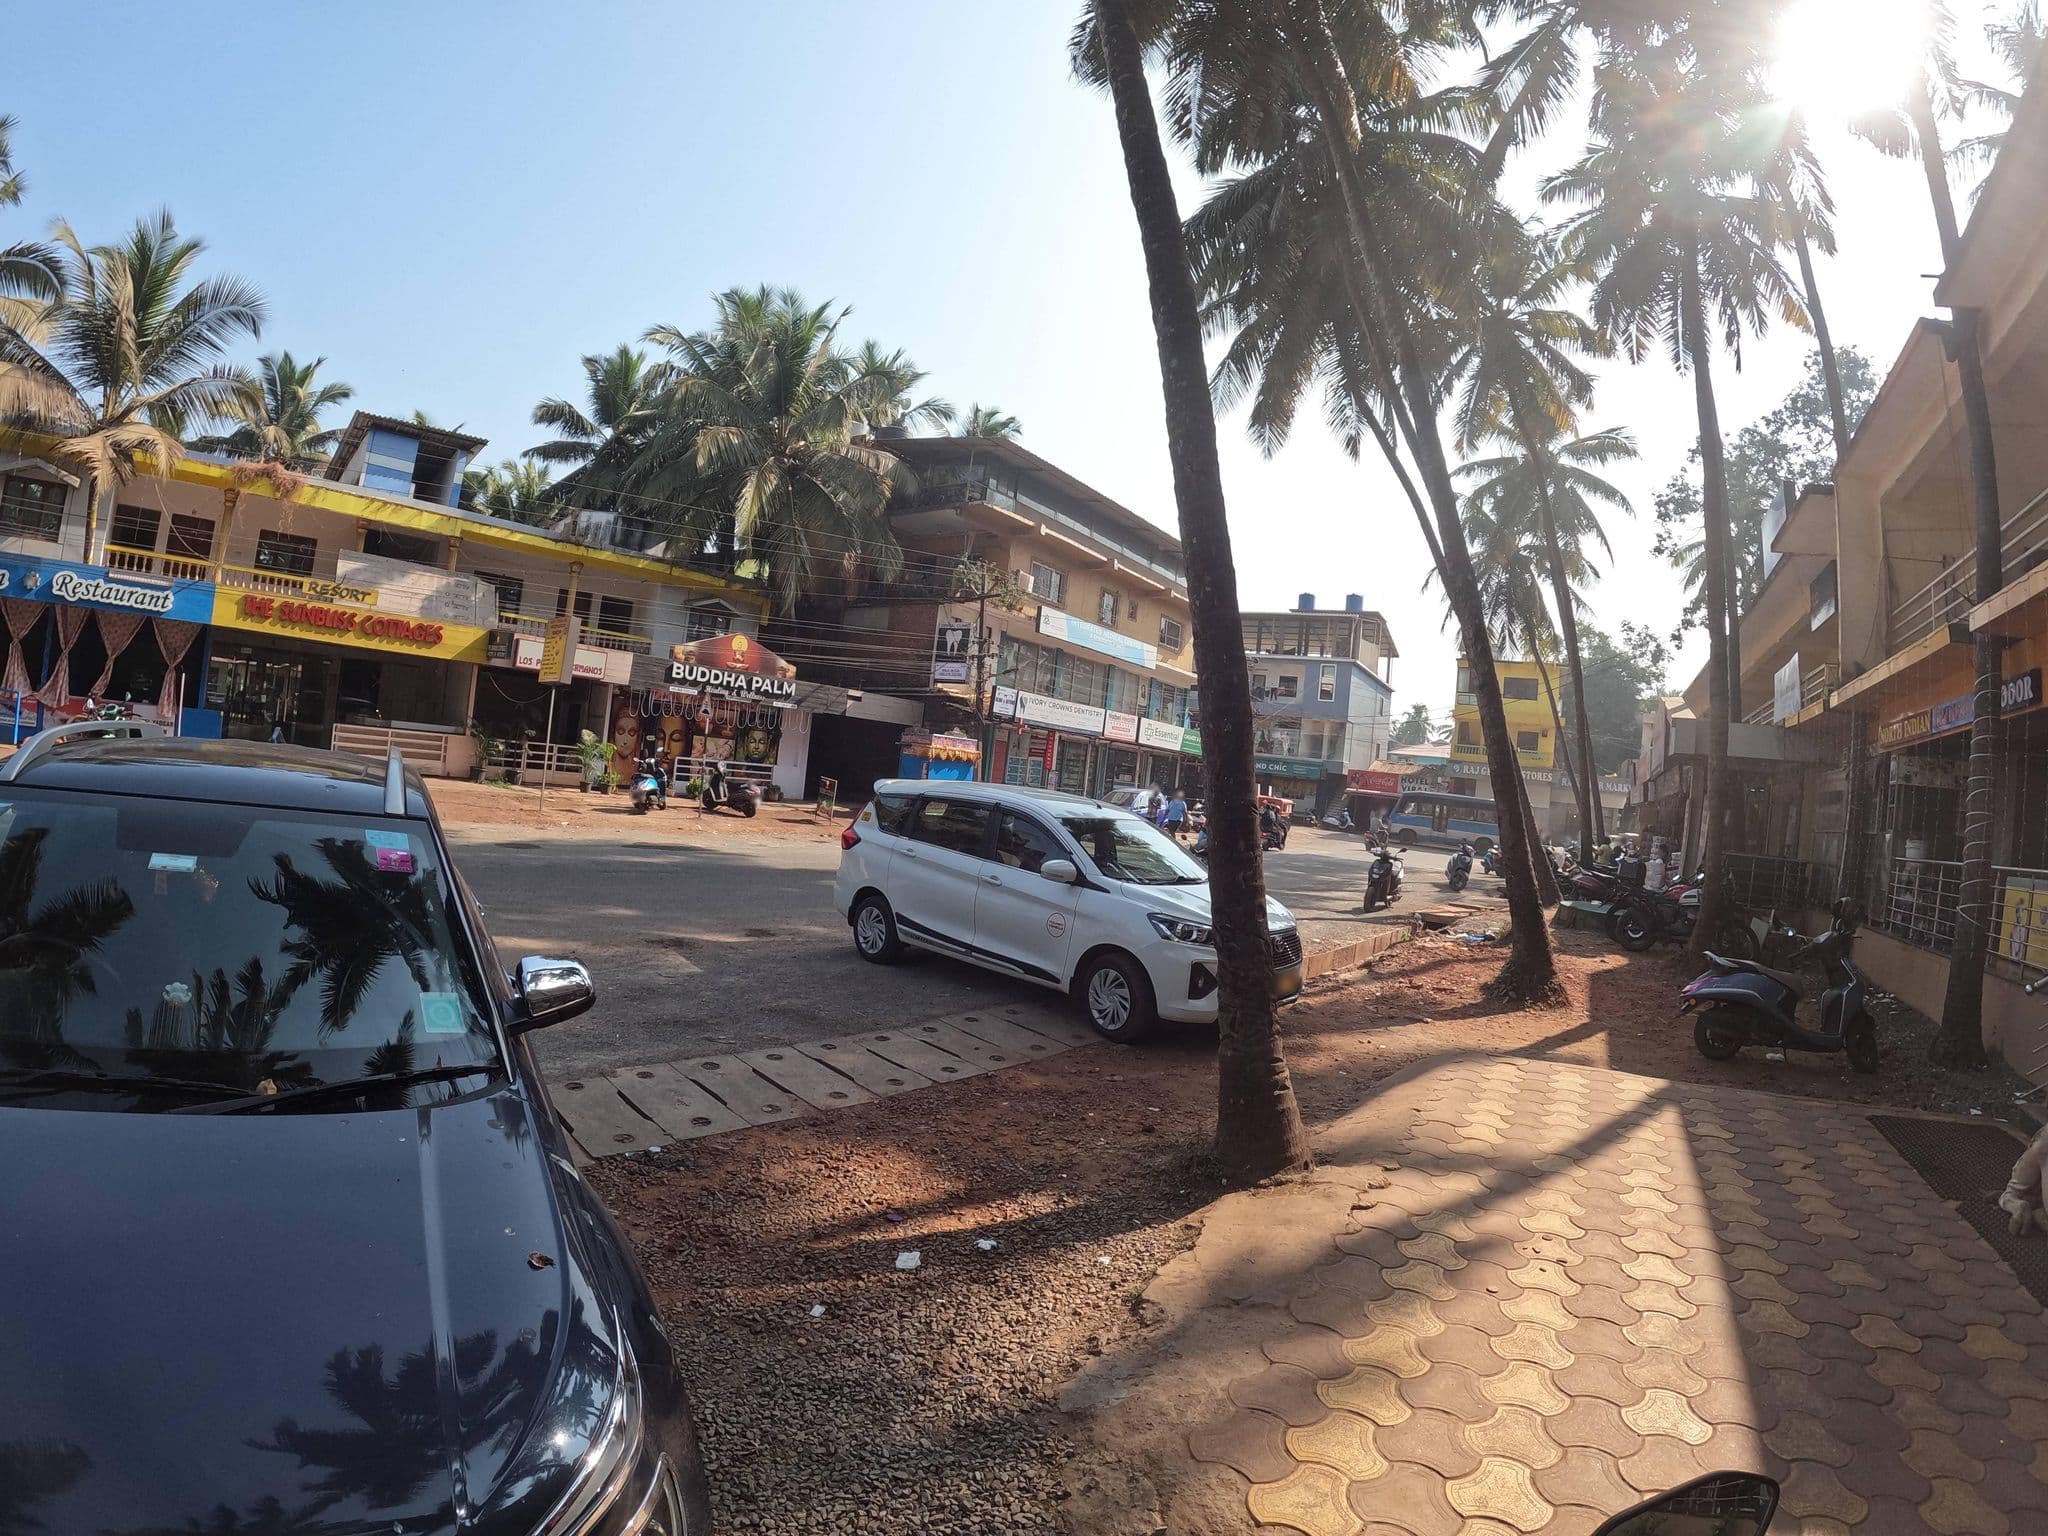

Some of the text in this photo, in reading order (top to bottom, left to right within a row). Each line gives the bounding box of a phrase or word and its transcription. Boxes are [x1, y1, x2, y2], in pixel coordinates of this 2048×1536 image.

[55, 573, 171, 609] Restaurant
[308, 581, 372, 602] RESORT
[243, 594, 443, 644] THE SUNBLISS COTTAGES
[519, 656, 532, 666] LOS
[572, 664, 603, 675] RMANOS
[672, 661, 796, 696] BUDDHA PALM
[1028, 697, 1047, 706] IVORY
[1048, 701, 1073, 712] CROWNS
[1074, 707, 1103, 718] DENTISTRY
[1155, 728, 1180, 741] Essential
[1255, 762, 1267, 770] ND
[1268, 763, 1287, 771] CHIC
[1401, 776, 1428, 785] HOTEL
